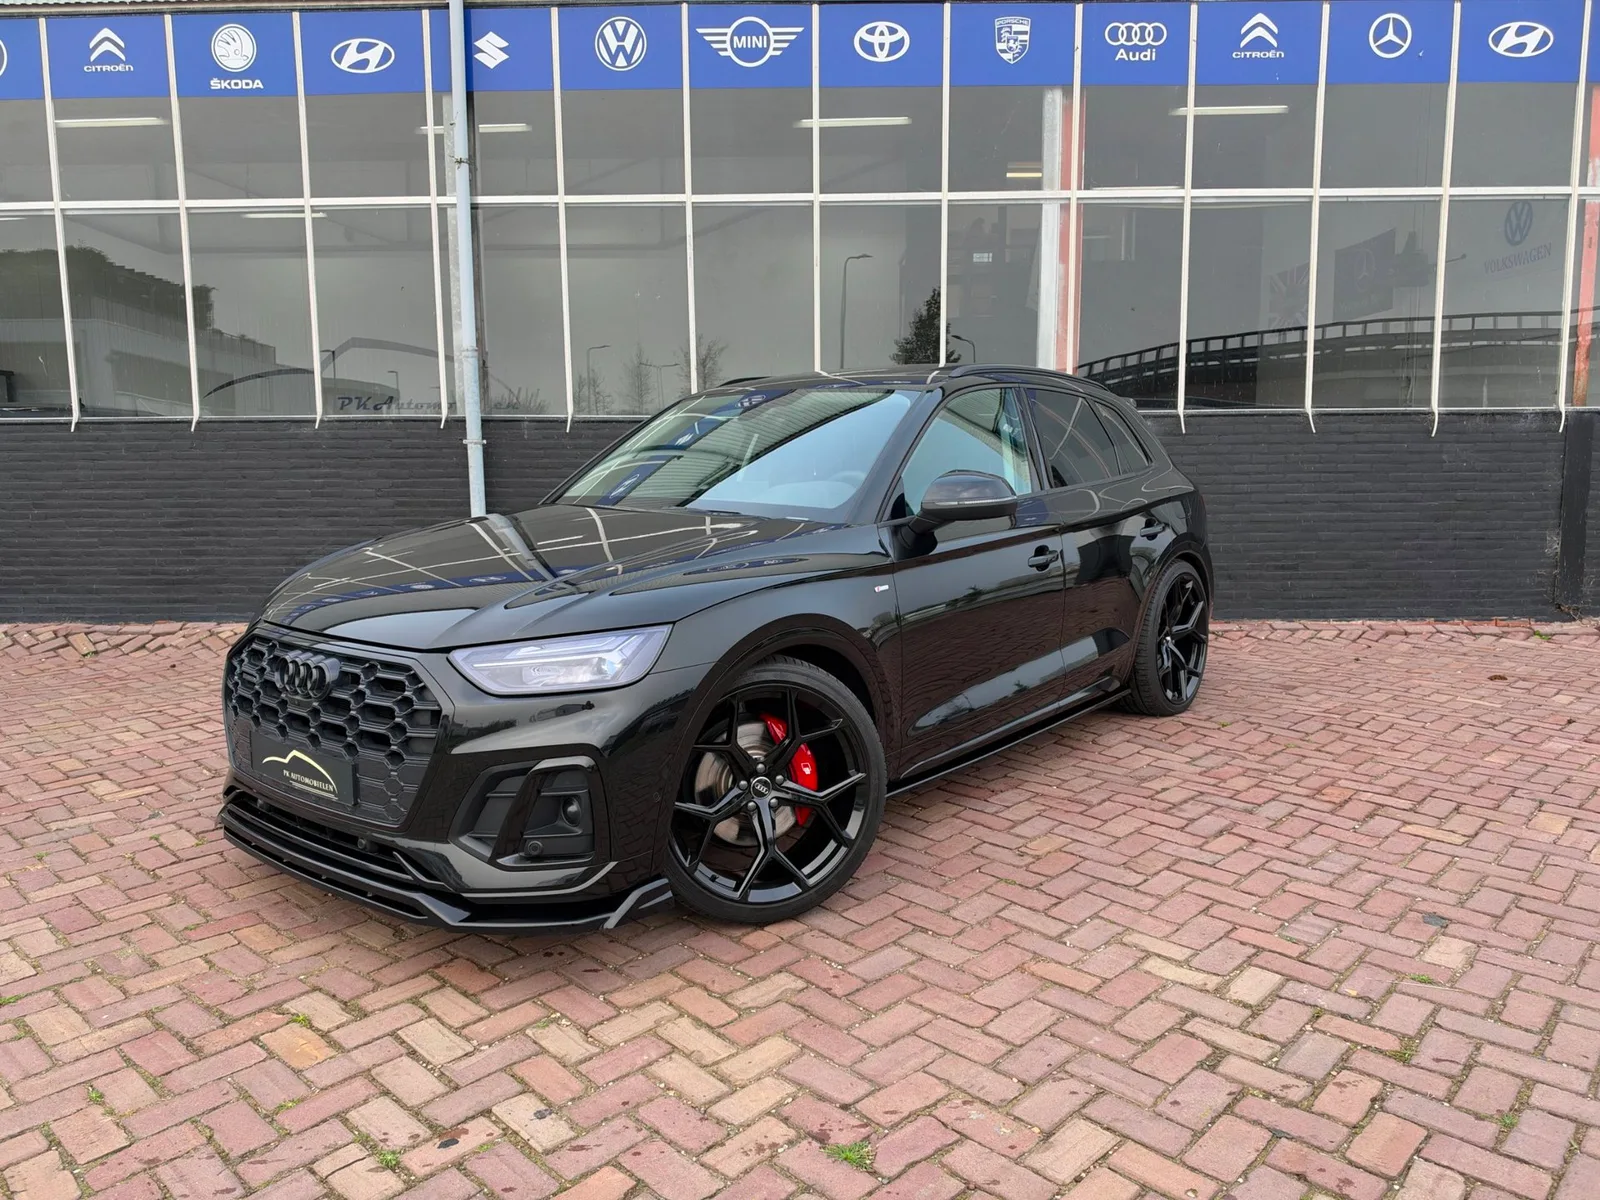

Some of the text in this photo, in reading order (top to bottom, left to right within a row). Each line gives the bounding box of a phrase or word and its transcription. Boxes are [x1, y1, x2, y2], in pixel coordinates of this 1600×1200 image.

[996, 18, 1029, 26] PORSCHE
[733, 35, 768, 49] MINI
[1114, 48, 1156, 61] Audi
[210, 77, 265, 90] ŠKODA
[1483, 241, 1552, 275] VOLKSWAGEN
[283, 769, 291, 778] PK
[290, 771, 334, 792] AUTOMOBIELEN
